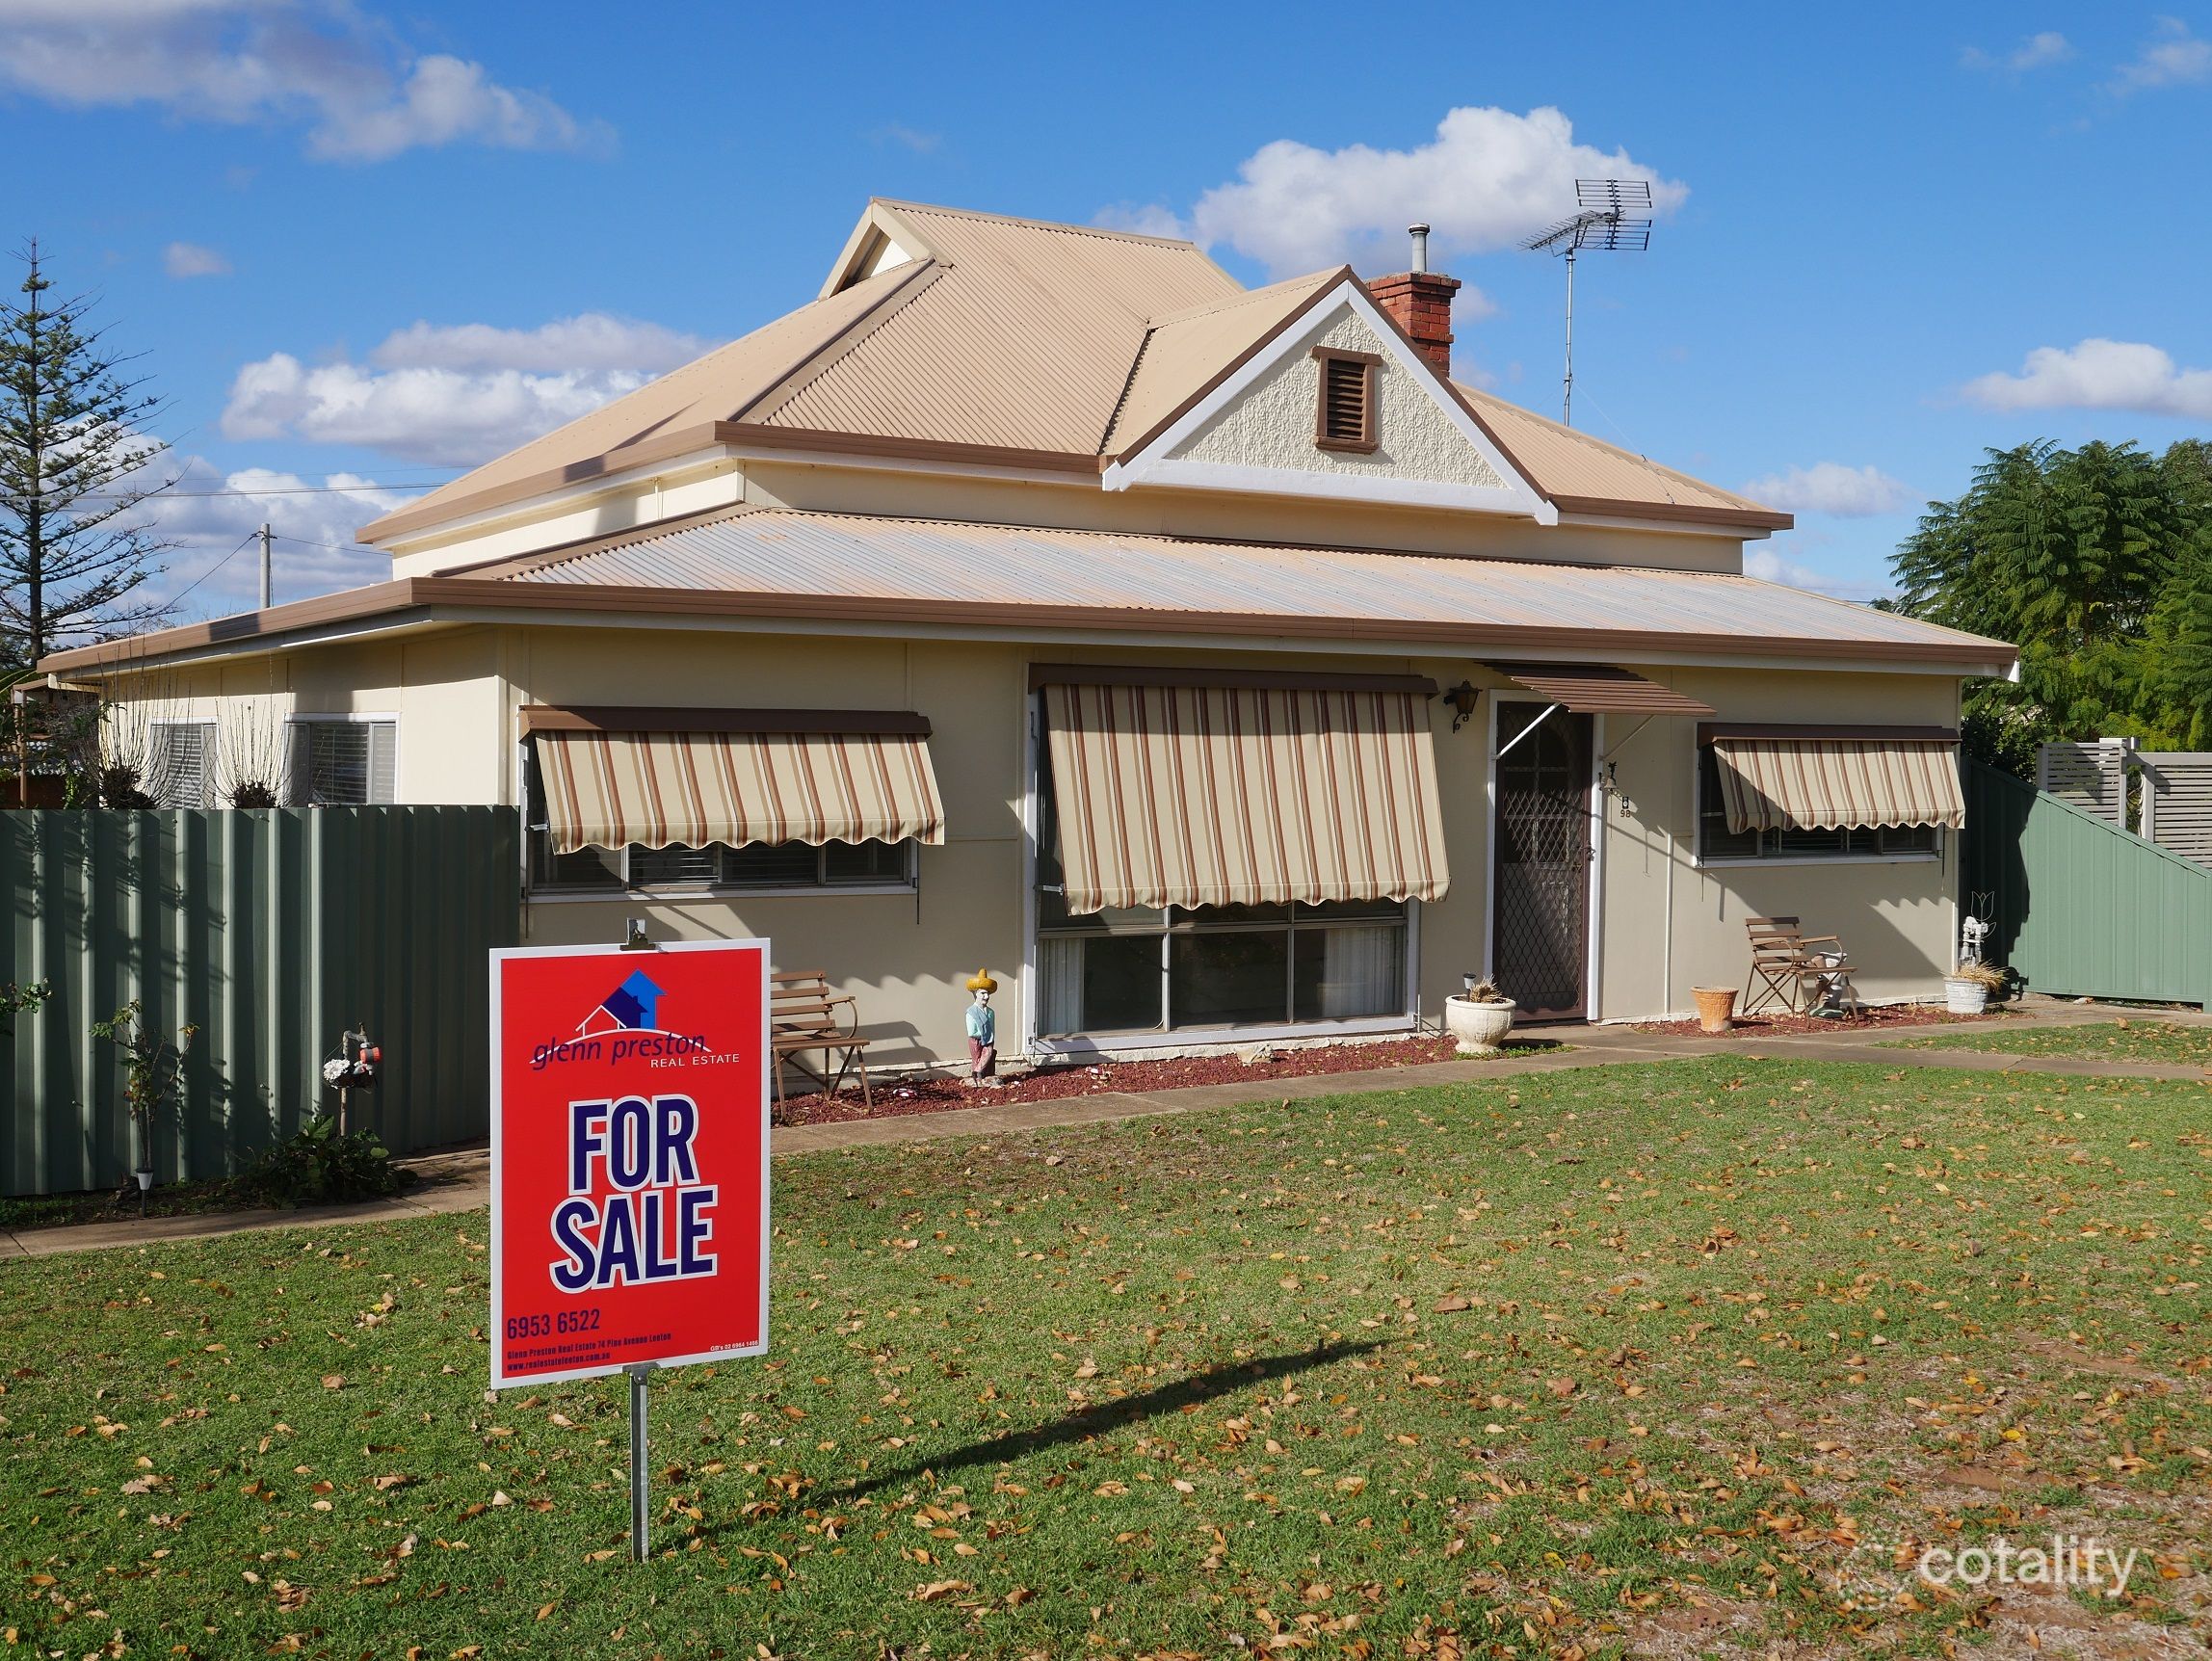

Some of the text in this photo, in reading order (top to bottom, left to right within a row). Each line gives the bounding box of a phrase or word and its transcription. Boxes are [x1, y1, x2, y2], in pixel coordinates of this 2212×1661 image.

[532, 1032, 705, 1070] glenn preston
[650, 1053, 740, 1068] REAL ESTATE
[568, 1094, 700, 1197] FOR
[549, 1184, 718, 1294] SALE
[507, 1308, 600, 1340] 6953 6522
[507, 1350, 528, 1359] Glenn
[529, 1347, 556, 1358] Preston
[559, 1345, 574, 1354] Real
[575, 1341, 596, 1352] Estate
[623, 1335, 647, 1346] Avenue
[649, 1332, 672, 1342] Leeton
